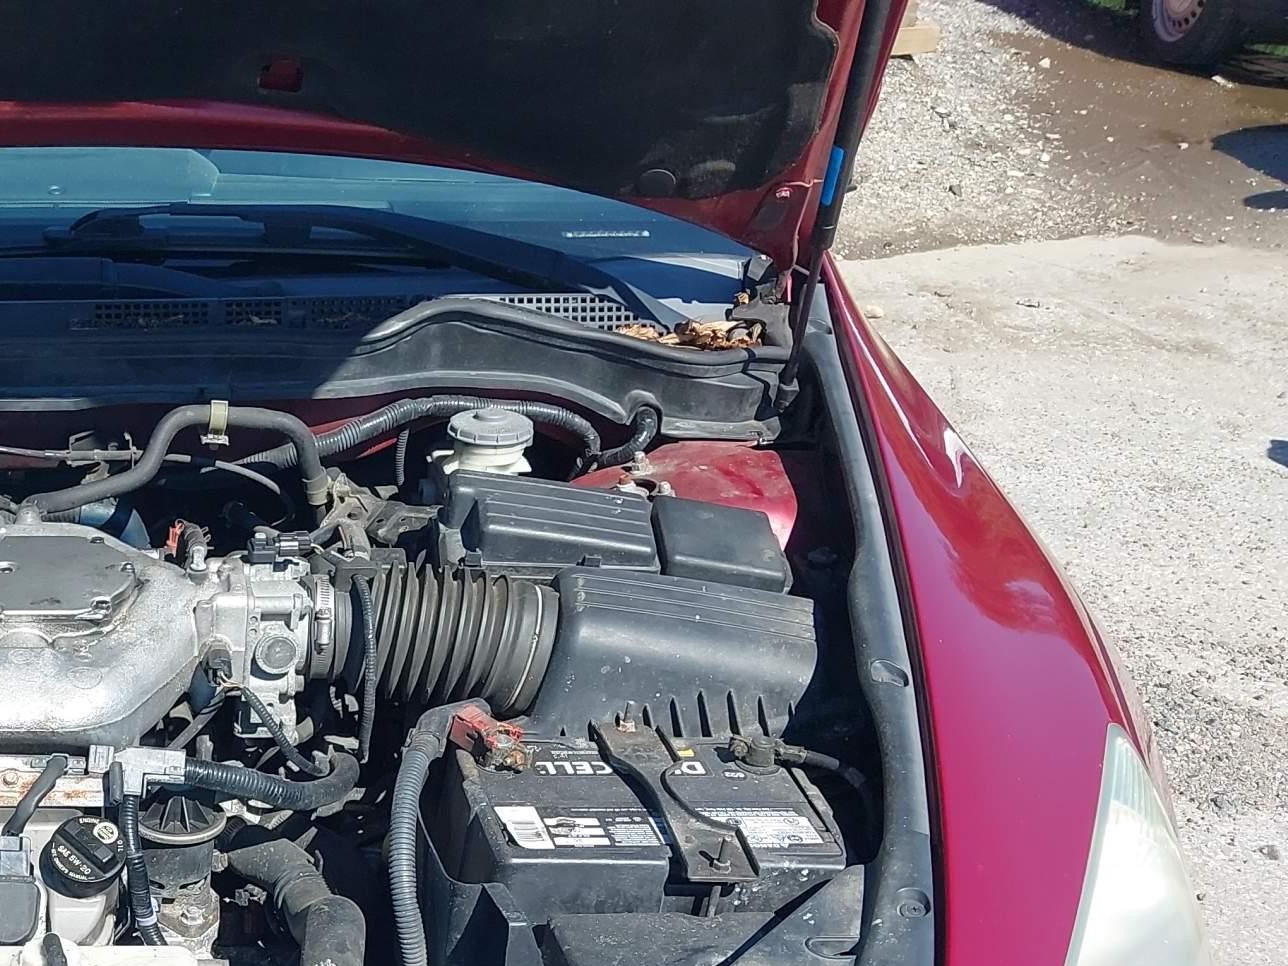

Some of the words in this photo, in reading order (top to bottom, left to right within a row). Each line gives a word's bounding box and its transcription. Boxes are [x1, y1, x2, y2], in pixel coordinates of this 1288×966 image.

[57, 845, 72, 858] SAE
[68, 855, 91, 875] 5W-20
[68, 872, 88, 880] MANUAL
